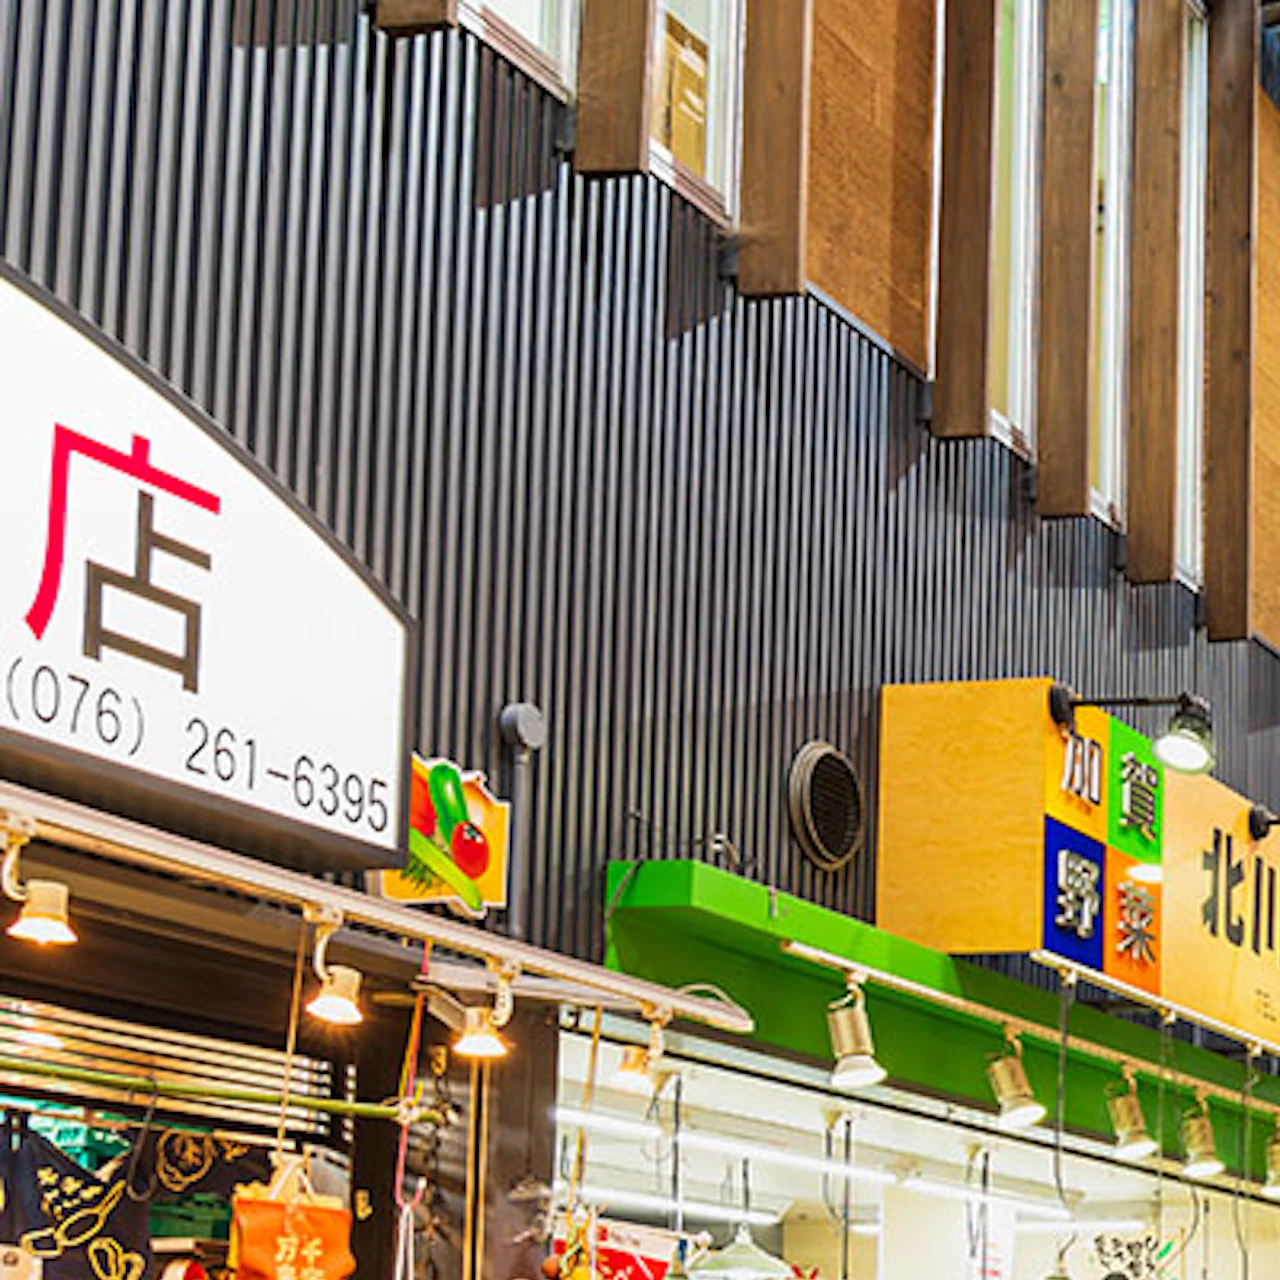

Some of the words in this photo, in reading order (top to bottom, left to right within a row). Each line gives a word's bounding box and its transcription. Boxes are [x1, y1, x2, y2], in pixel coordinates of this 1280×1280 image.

[24, 421, 221, 695] 店
[5, 657, 146, 757] (076)
[184, 717, 390, 834] 261-6395
[1054, 848, 1156, 963] 野菜
